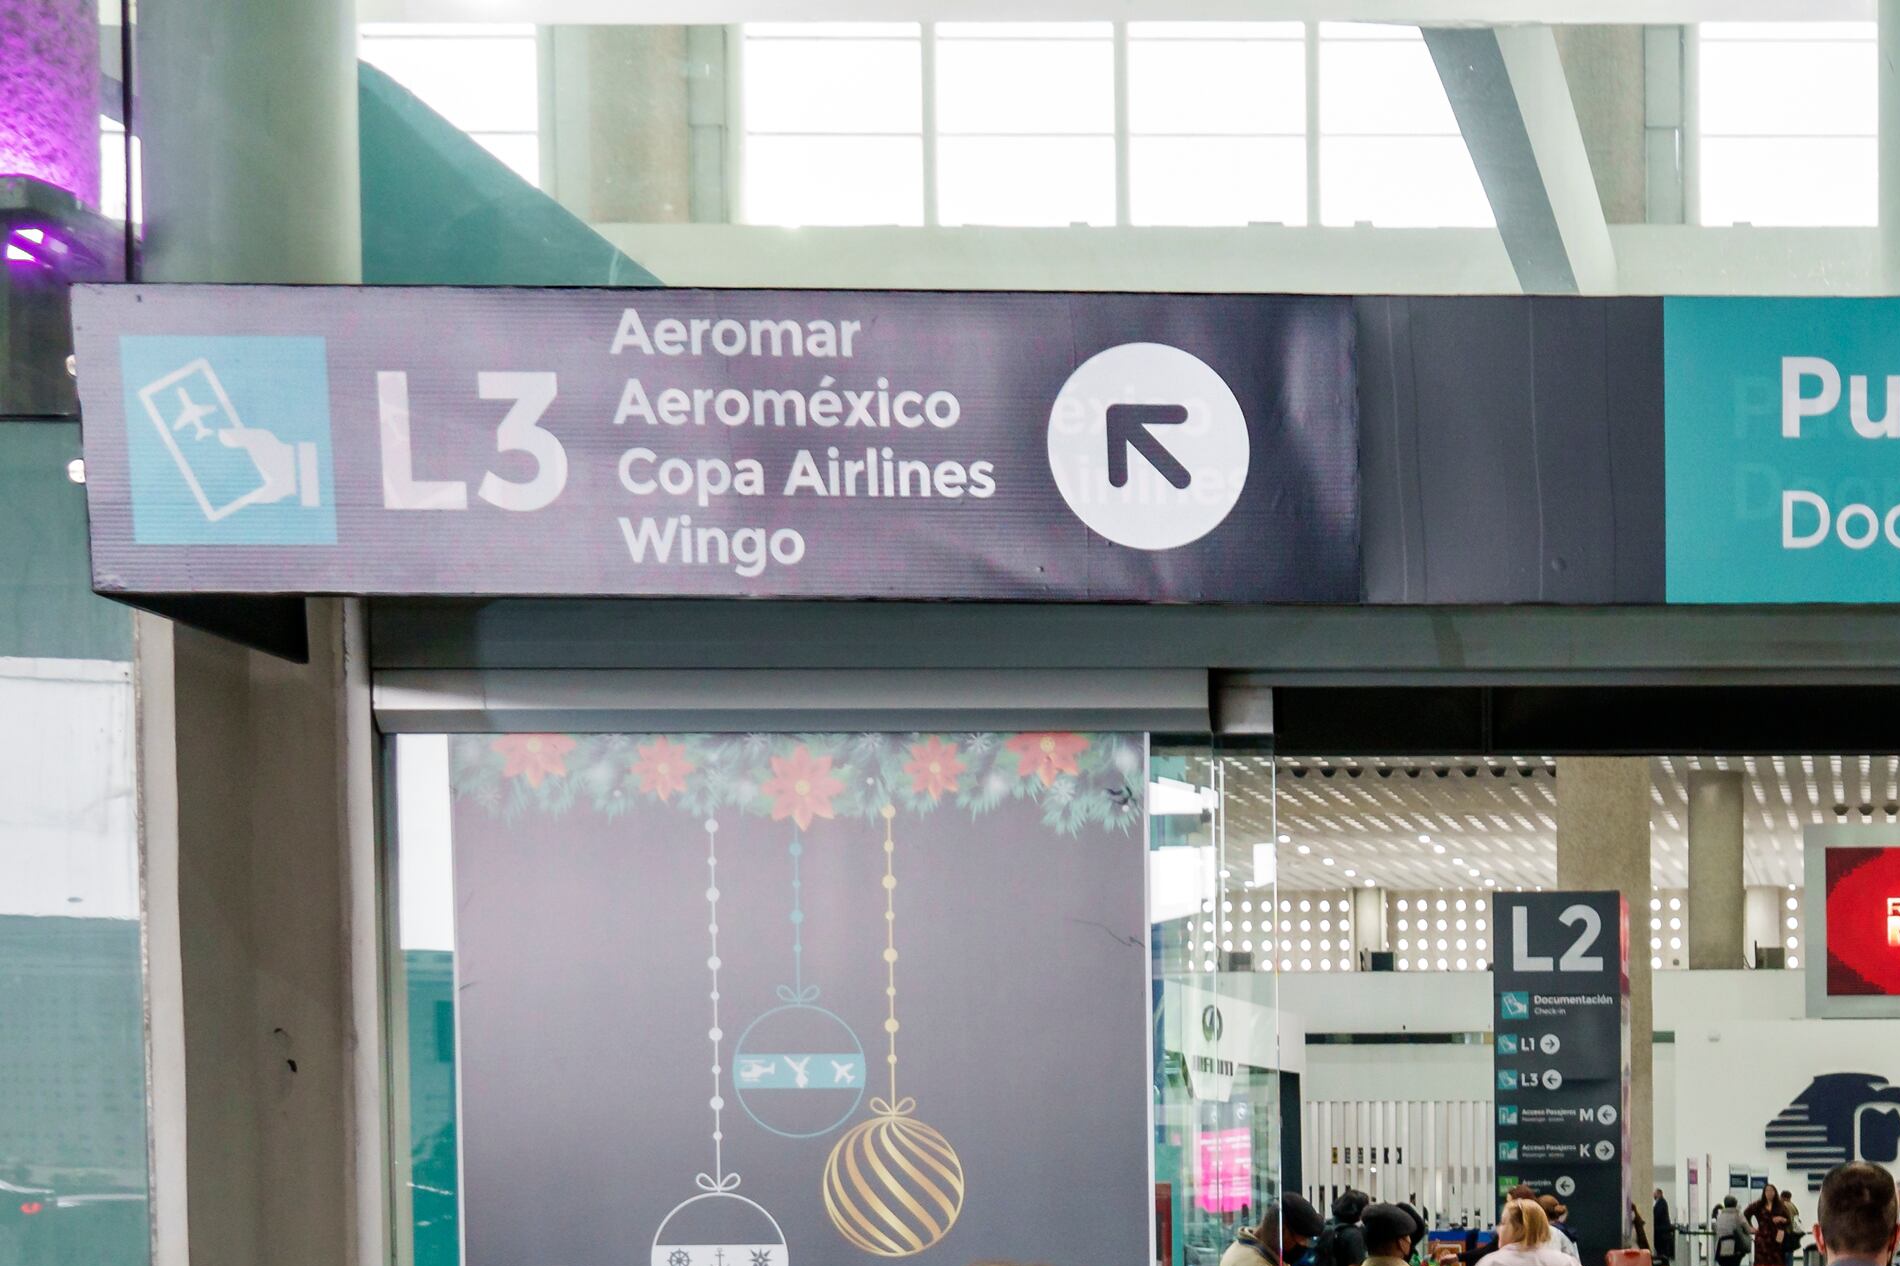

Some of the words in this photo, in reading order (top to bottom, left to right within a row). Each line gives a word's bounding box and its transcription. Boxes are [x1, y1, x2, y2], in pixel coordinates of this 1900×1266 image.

[608, 308, 862, 358] Aeromar
[612, 375, 961, 429] Aeroméxico
[376, 370, 569, 512] L3
[616, 447, 765, 506] Copa
[783, 446, 996, 499] Airlines
[616, 513, 806, 578] Wingo
[1512, 904, 1604, 972] L2
[1533, 994, 1613, 1005] Documentación
[1533, 1007, 1567, 1015] Check-in
[1520, 1037, 1535, 1051] L1
[1520, 1072, 1539, 1087] L3
[1579, 1108, 1594, 1122] M
[1579, 1143, 1591, 1158] K
